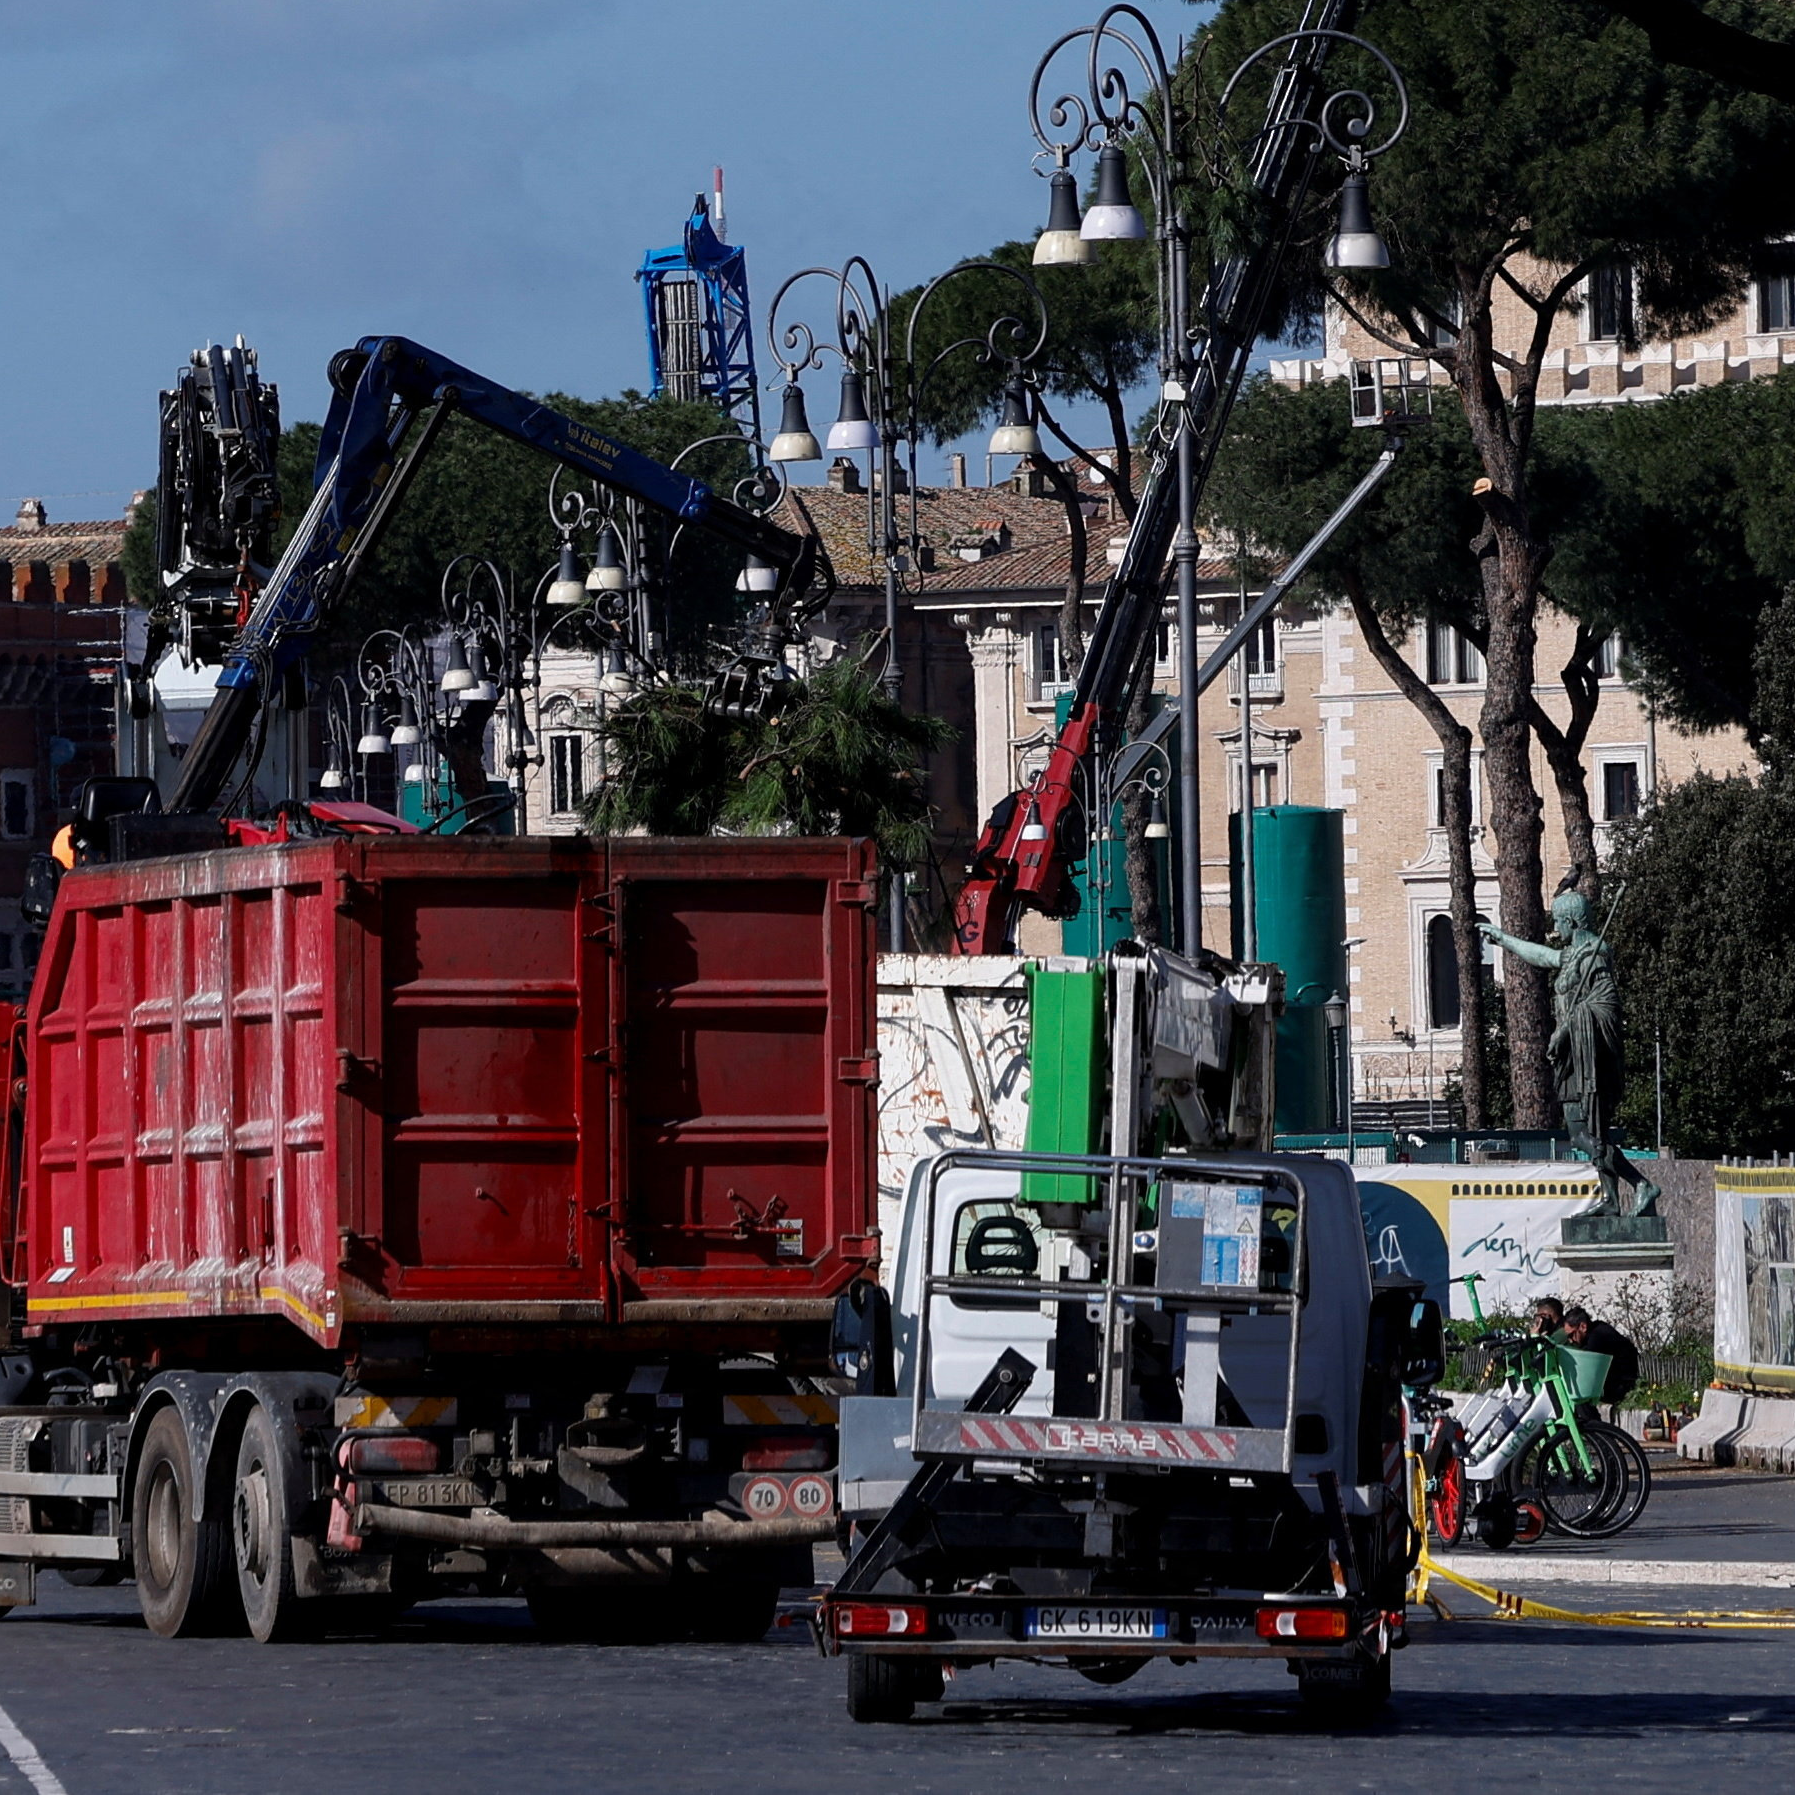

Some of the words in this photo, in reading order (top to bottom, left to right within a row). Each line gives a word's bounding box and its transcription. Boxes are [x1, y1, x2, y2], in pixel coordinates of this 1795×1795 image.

[1499, 1419, 1537, 1458] Lime
[754, 1489, 775, 1508] 70
[799, 1487, 821, 1505] 80
[937, 1612, 995, 1626] IVECO
[1040, 1610, 1067, 1634] GK
[1078, 1610, 1151, 1635] 619KN
[1190, 1616, 1246, 1629] DAILY
[1309, 1668, 1361, 1681] COMET
